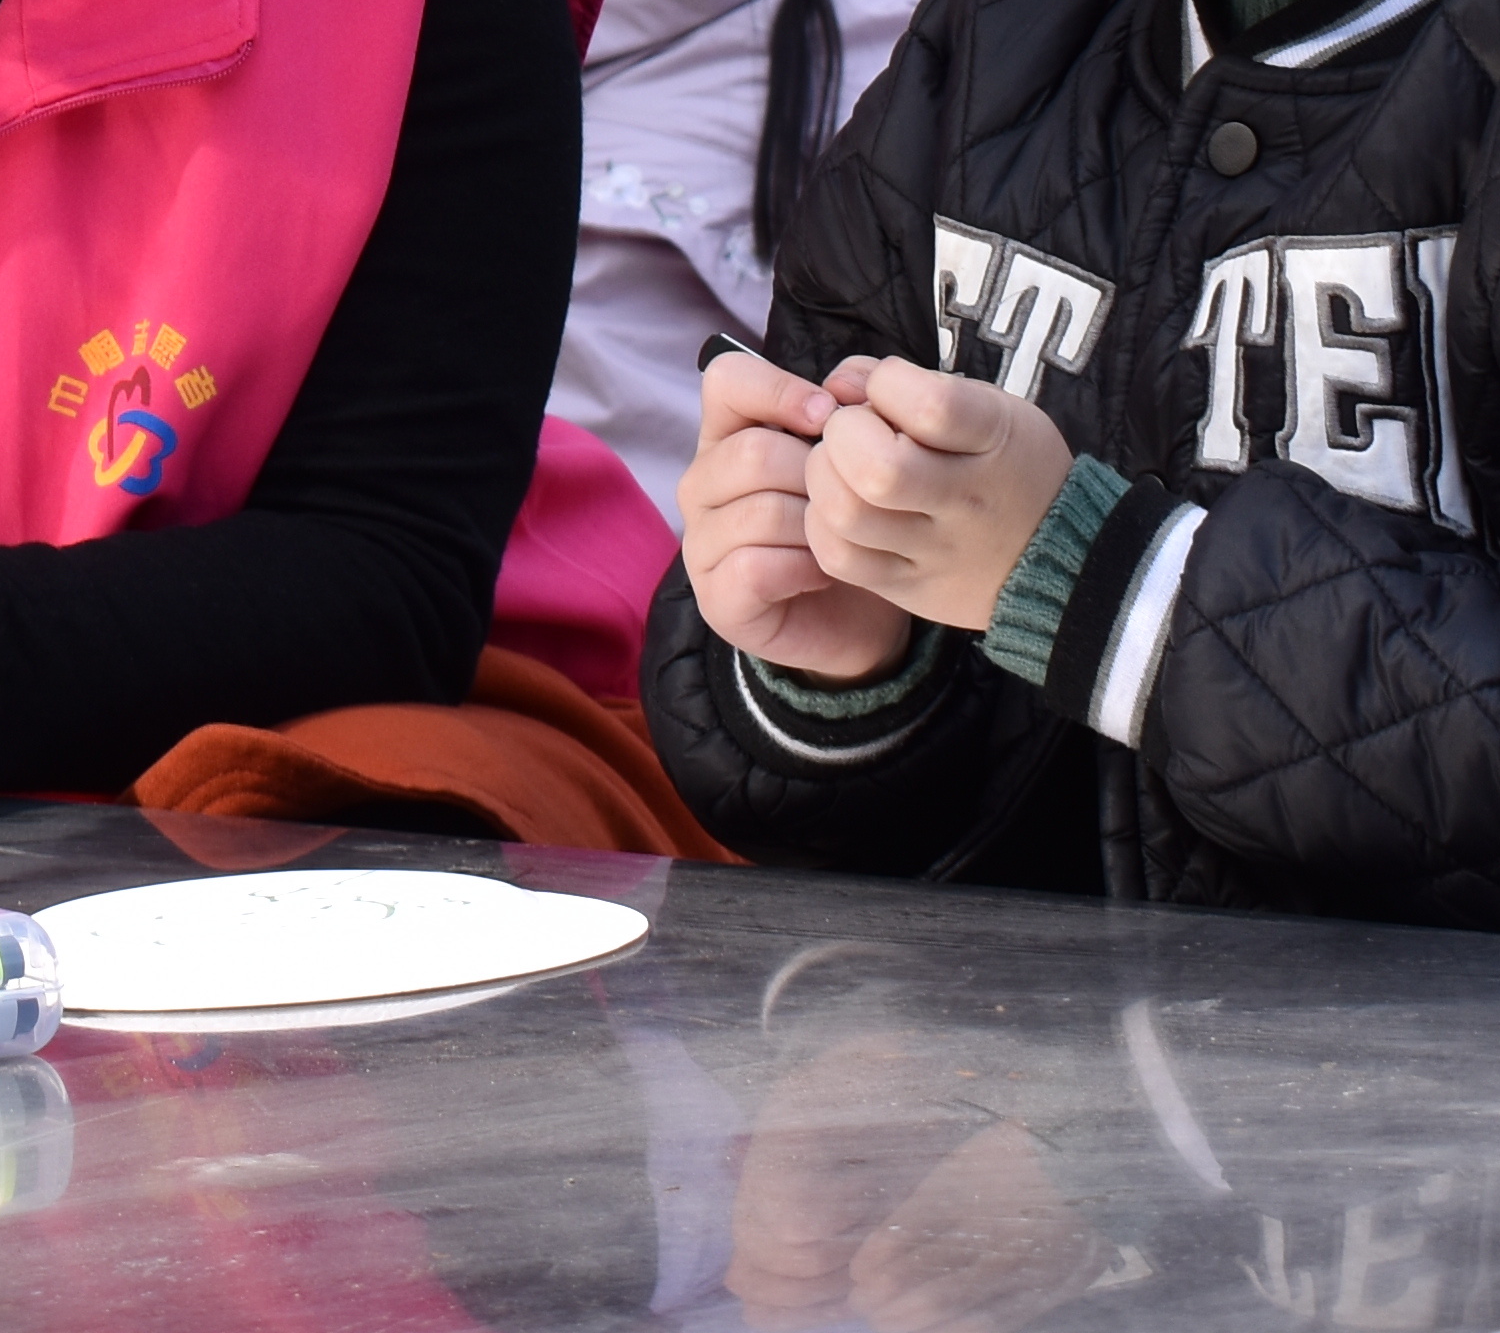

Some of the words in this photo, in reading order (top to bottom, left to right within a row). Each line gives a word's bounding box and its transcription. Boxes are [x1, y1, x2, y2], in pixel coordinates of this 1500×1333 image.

[47, 318, 219, 419] 巾帼志愿者
